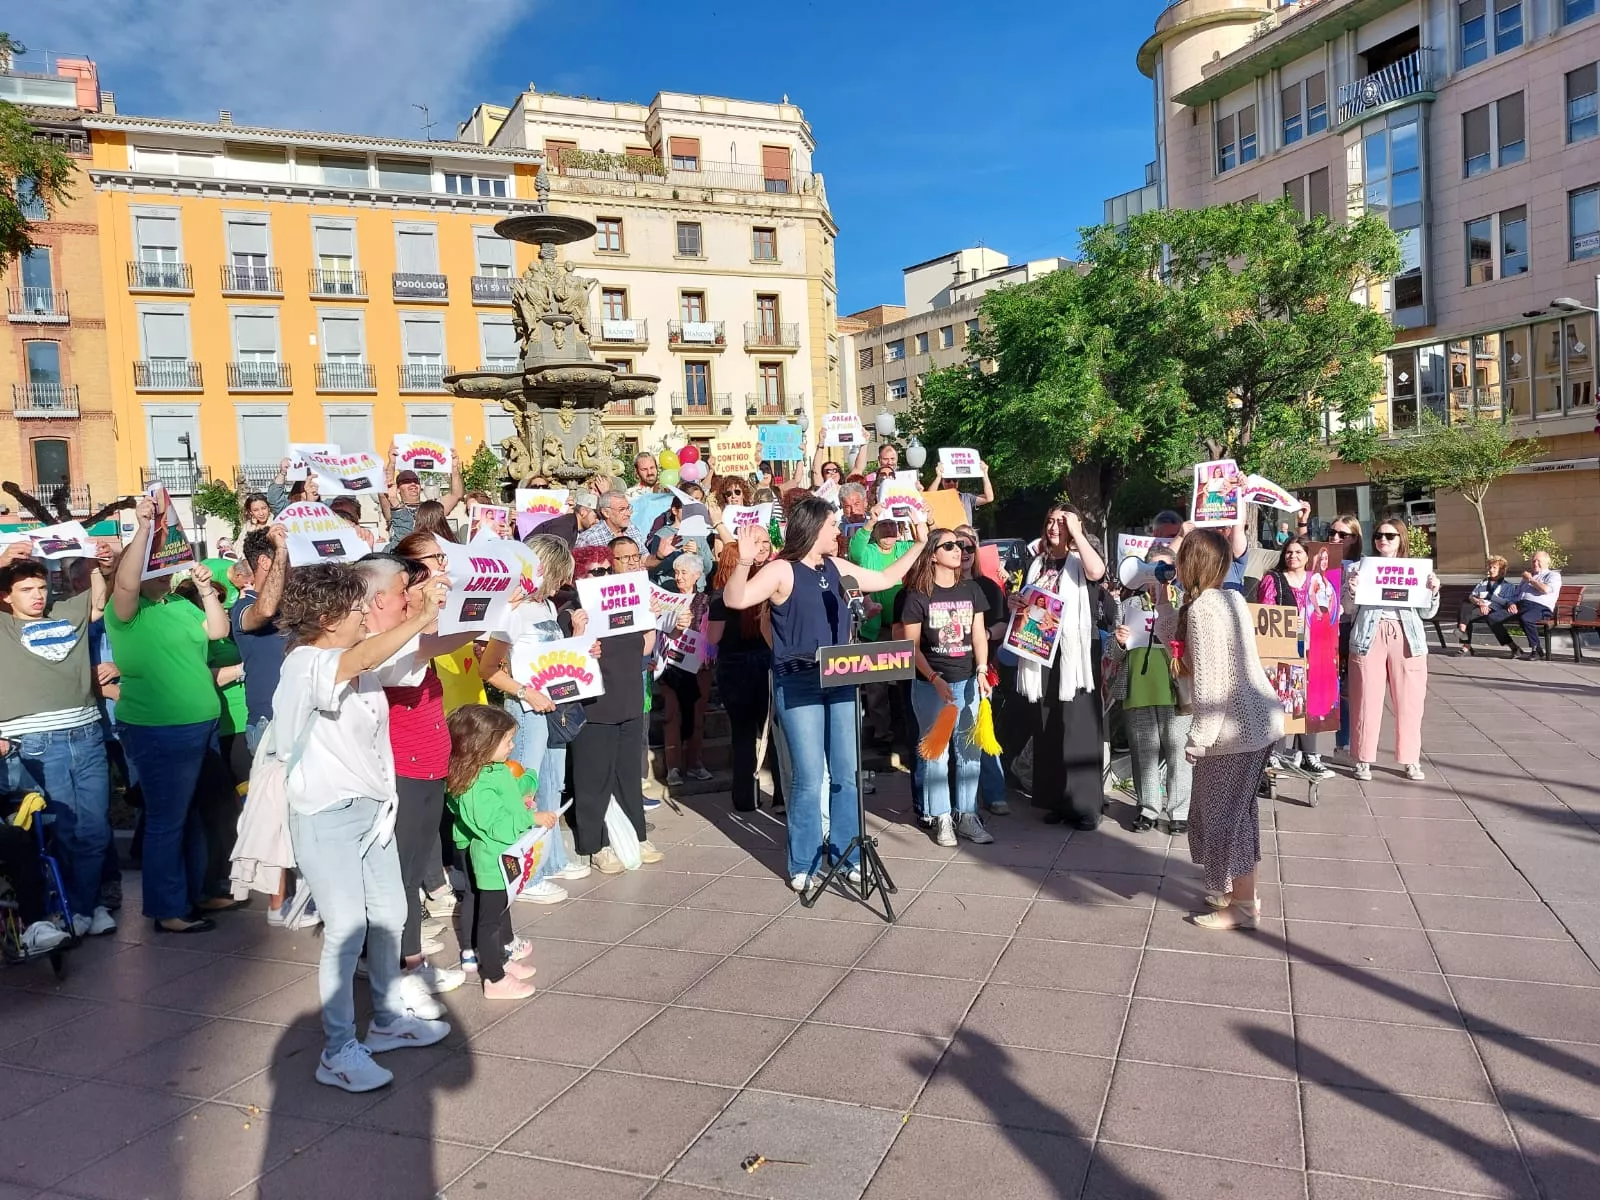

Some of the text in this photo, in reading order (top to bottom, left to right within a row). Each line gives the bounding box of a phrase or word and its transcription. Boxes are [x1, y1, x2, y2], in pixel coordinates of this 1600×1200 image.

[395, 279, 446, 290] PODÓLOGO
[717, 441, 752, 451] ESTAMOS
[360, 453, 369, 462] A
[401, 447, 447, 465] GANADORA
[717, 453, 749, 462] CONTIGO
[721, 464, 749, 473] LORENA
[280, 505, 331, 521] LORENA
[165, 542, 180, 551] VOTA
[469, 556, 509, 573] VOTA A
[1376, 566, 1415, 576] VOTA A
[463, 576, 512, 592] LORENA
[1375, 576, 1419, 586] LORENA
[600, 582, 636, 598] VOTA A
[601, 594, 641, 611] LORENA
[928, 601, 956, 610] LORENA
[823, 651, 913, 676] JOTALENT
